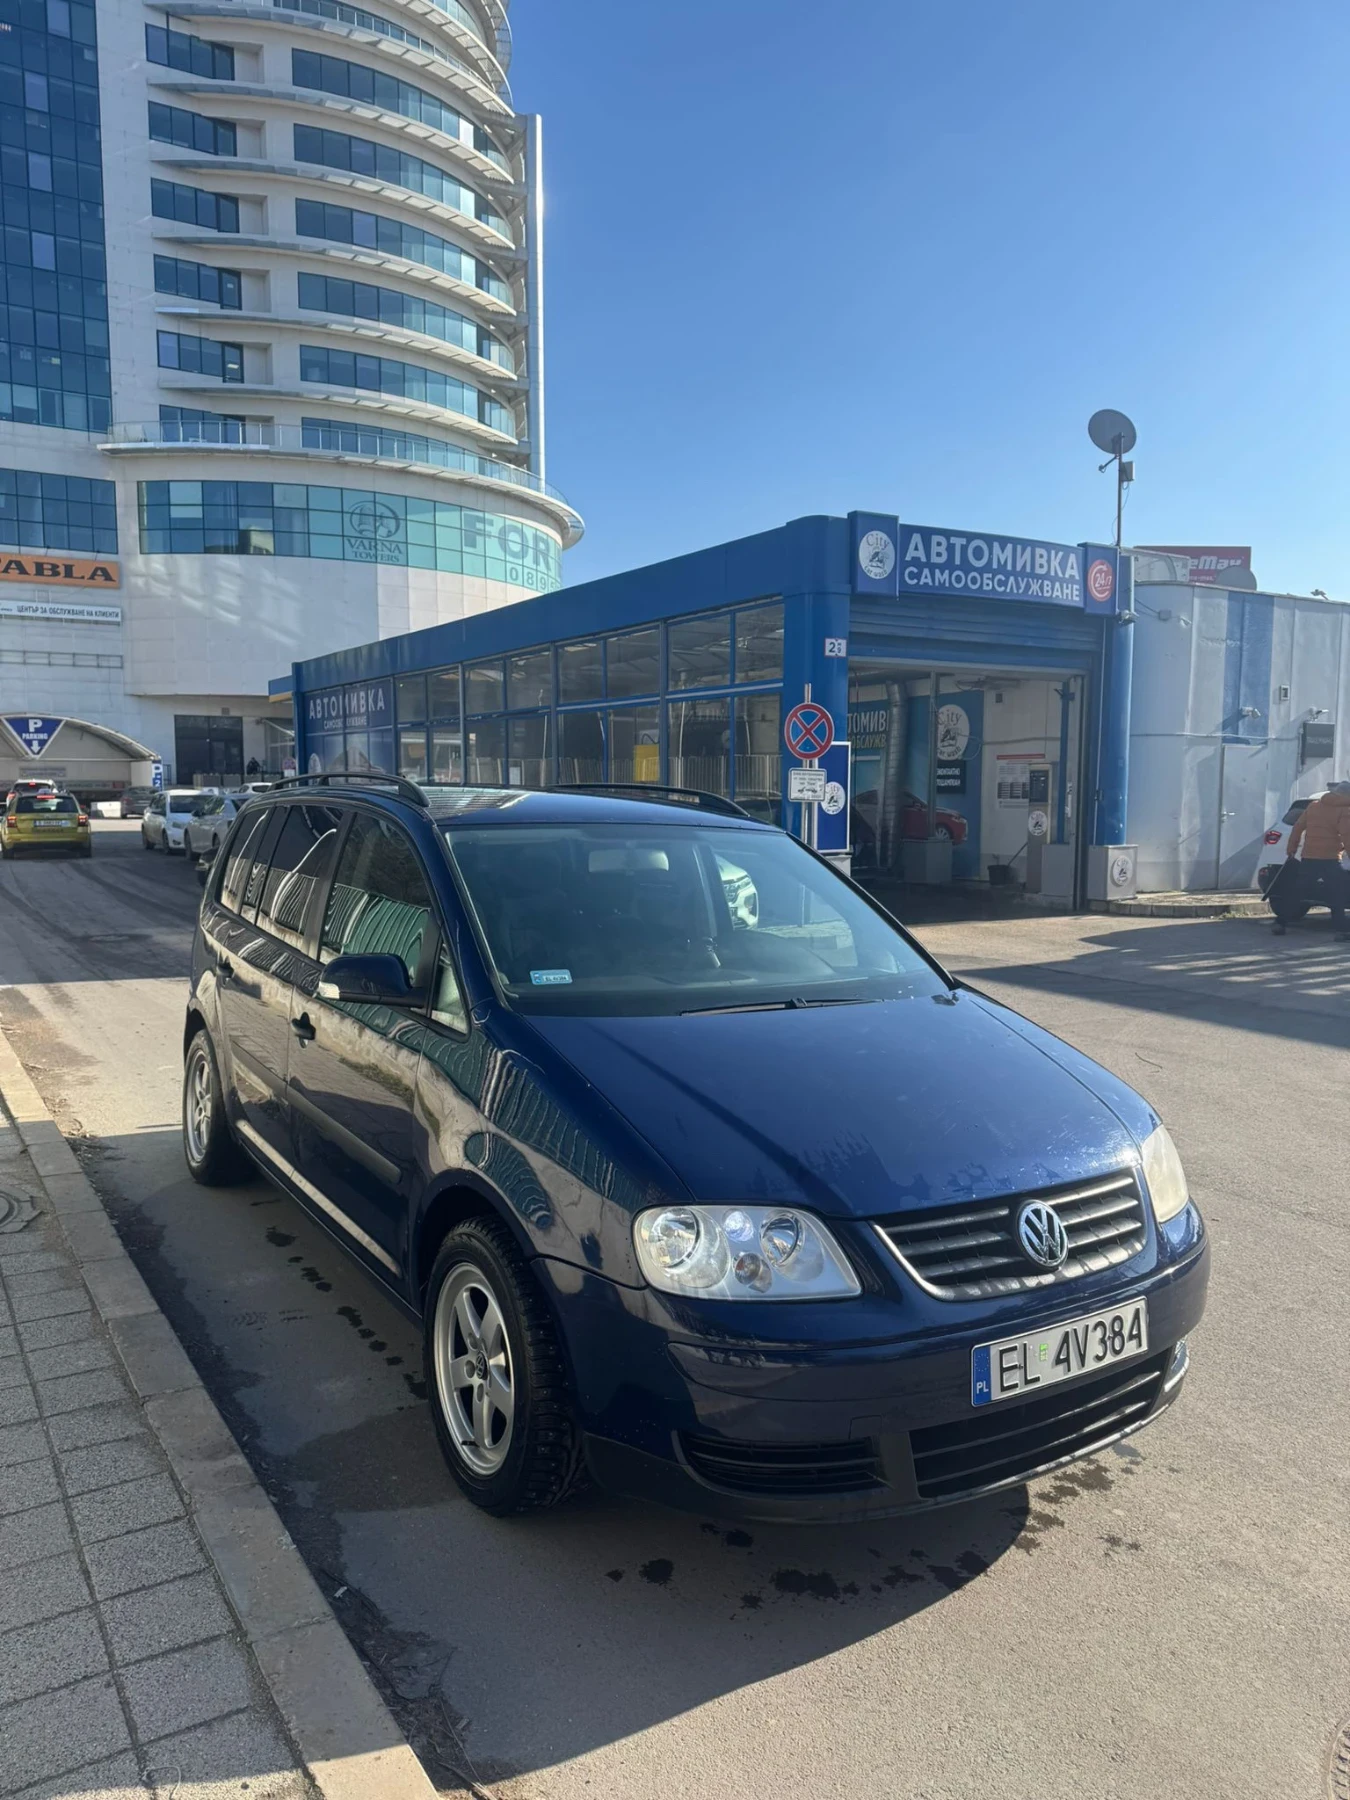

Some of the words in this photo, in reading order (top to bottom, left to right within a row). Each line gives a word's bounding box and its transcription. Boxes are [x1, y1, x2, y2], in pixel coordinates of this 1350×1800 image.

[346, 537, 403, 555] VARNA
[463, 512, 552, 573] FOR
[866, 533, 890, 550] City
[352, 550, 400, 563] TOWERS
[904, 533, 1080, 580] АВТОМИВКА
[0, 557, 116, 582] ABLA
[904, 566, 1080, 600] САМООБСЛУЖВАНЕ
[1095, 572, 1112, 588] 24/7
[828, 641, 836, 653] 2
[28, 719, 43, 732] P
[999, 1343, 1041, 1392] EL
[1052, 1307, 1143, 1374] 4V384
[976, 1381, 990, 1394] PL
